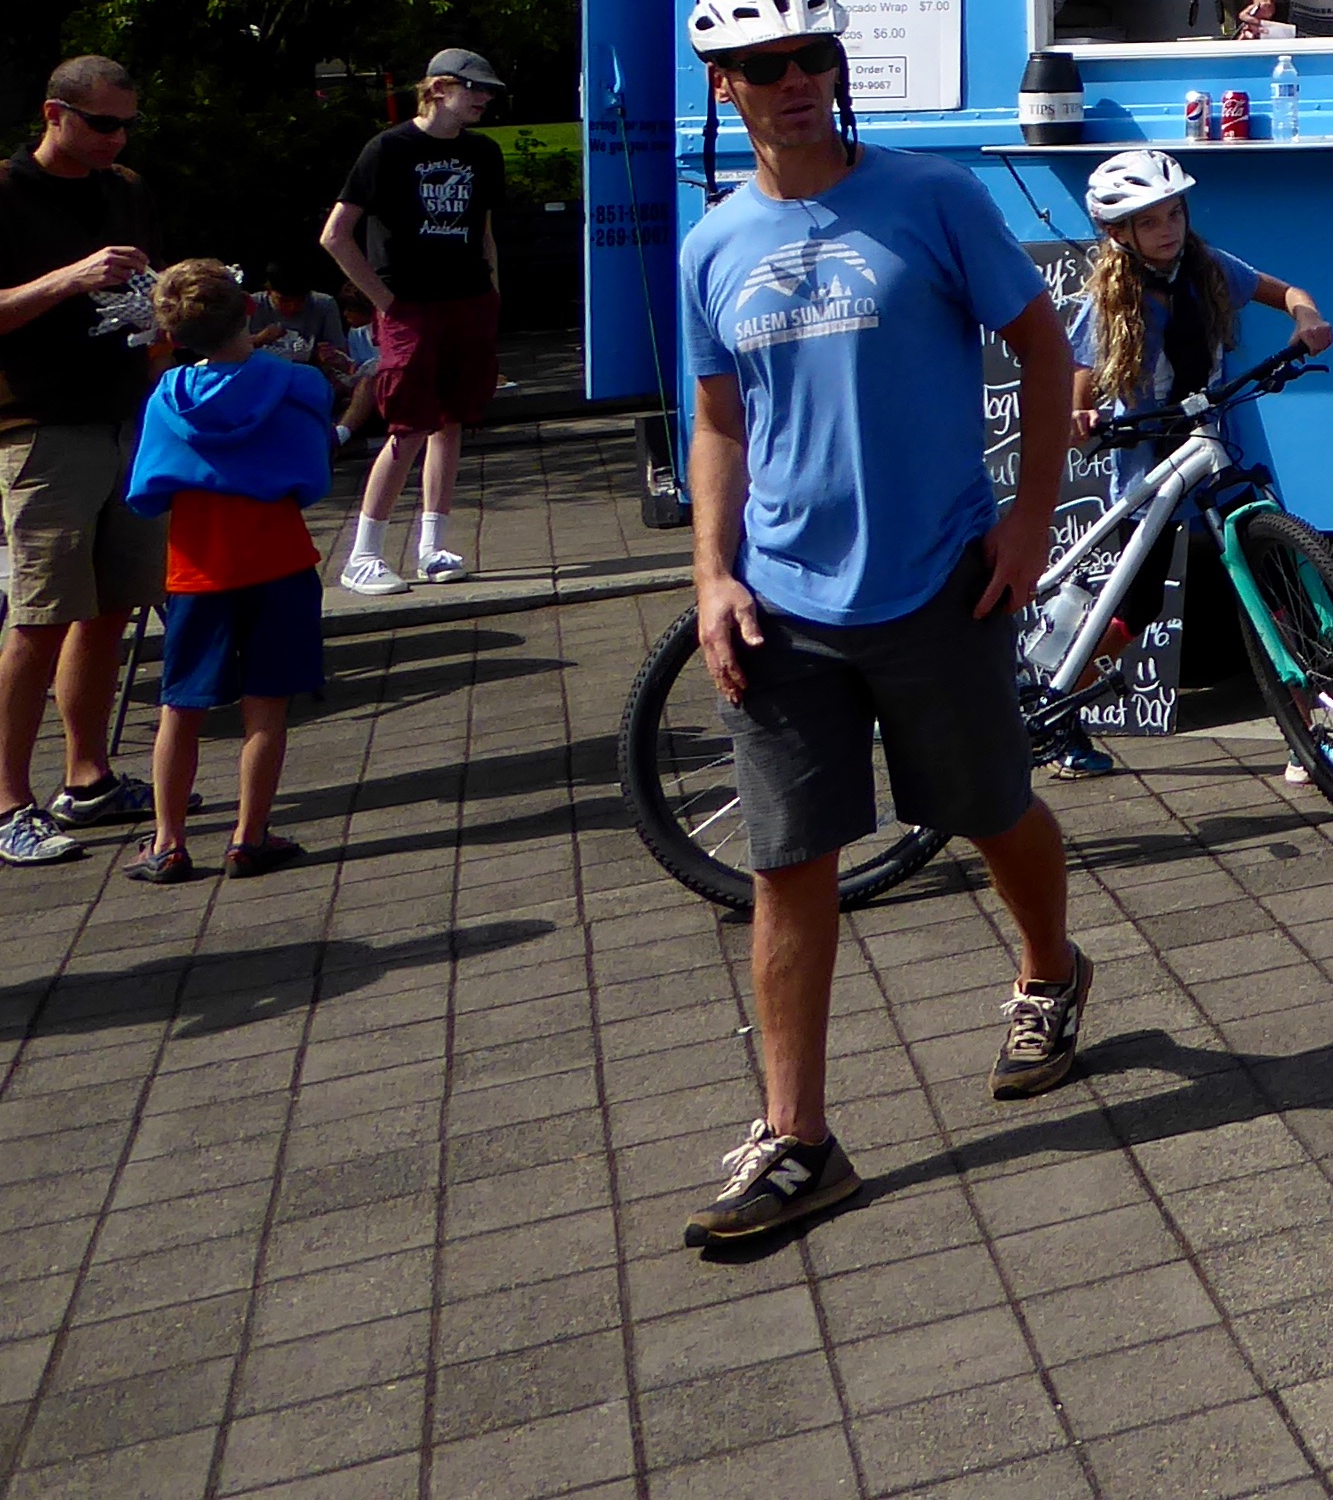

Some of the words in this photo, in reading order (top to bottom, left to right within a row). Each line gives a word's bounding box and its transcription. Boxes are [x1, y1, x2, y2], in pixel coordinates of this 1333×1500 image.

[846, 2, 877, 13] ocado
[880, 1, 908, 13] Wrap
[919, 0, 950, 11] $7.00
[873, 28, 906, 39] $6.00
[855, 65, 885, 74] Order
[888, 64, 902, 73] To
[1029, 104, 1055, 115] TIPS
[735, 311, 787, 341] SALEM
[791, 299, 851, 326] SUMMIT
[854, 297, 880, 316] CO.
